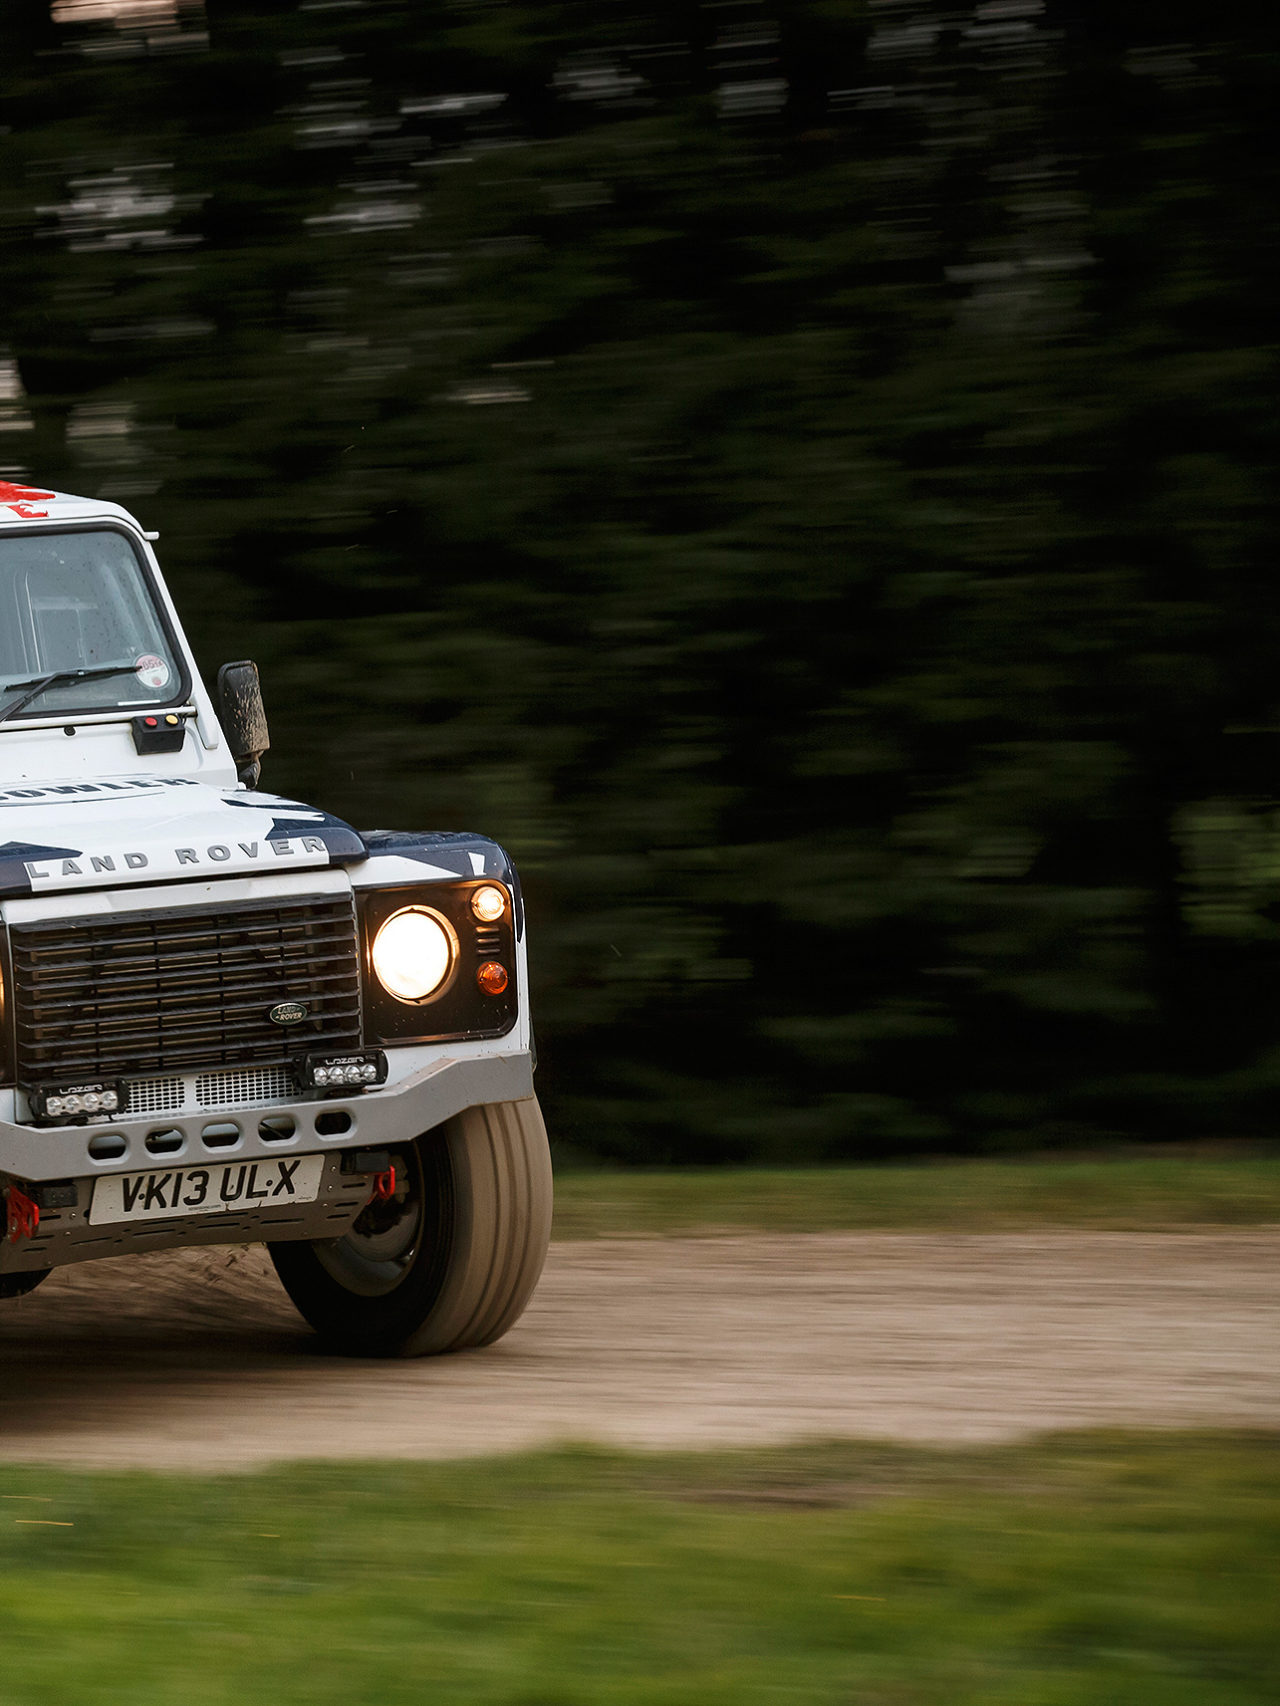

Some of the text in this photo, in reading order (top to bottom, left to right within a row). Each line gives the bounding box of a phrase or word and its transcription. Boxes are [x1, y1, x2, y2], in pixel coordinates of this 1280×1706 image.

[28, 835, 326, 879] LAND ROVER
[280, 1012, 303, 1021] ROVER
[122, 1159, 302, 1213] VK13 ULX
